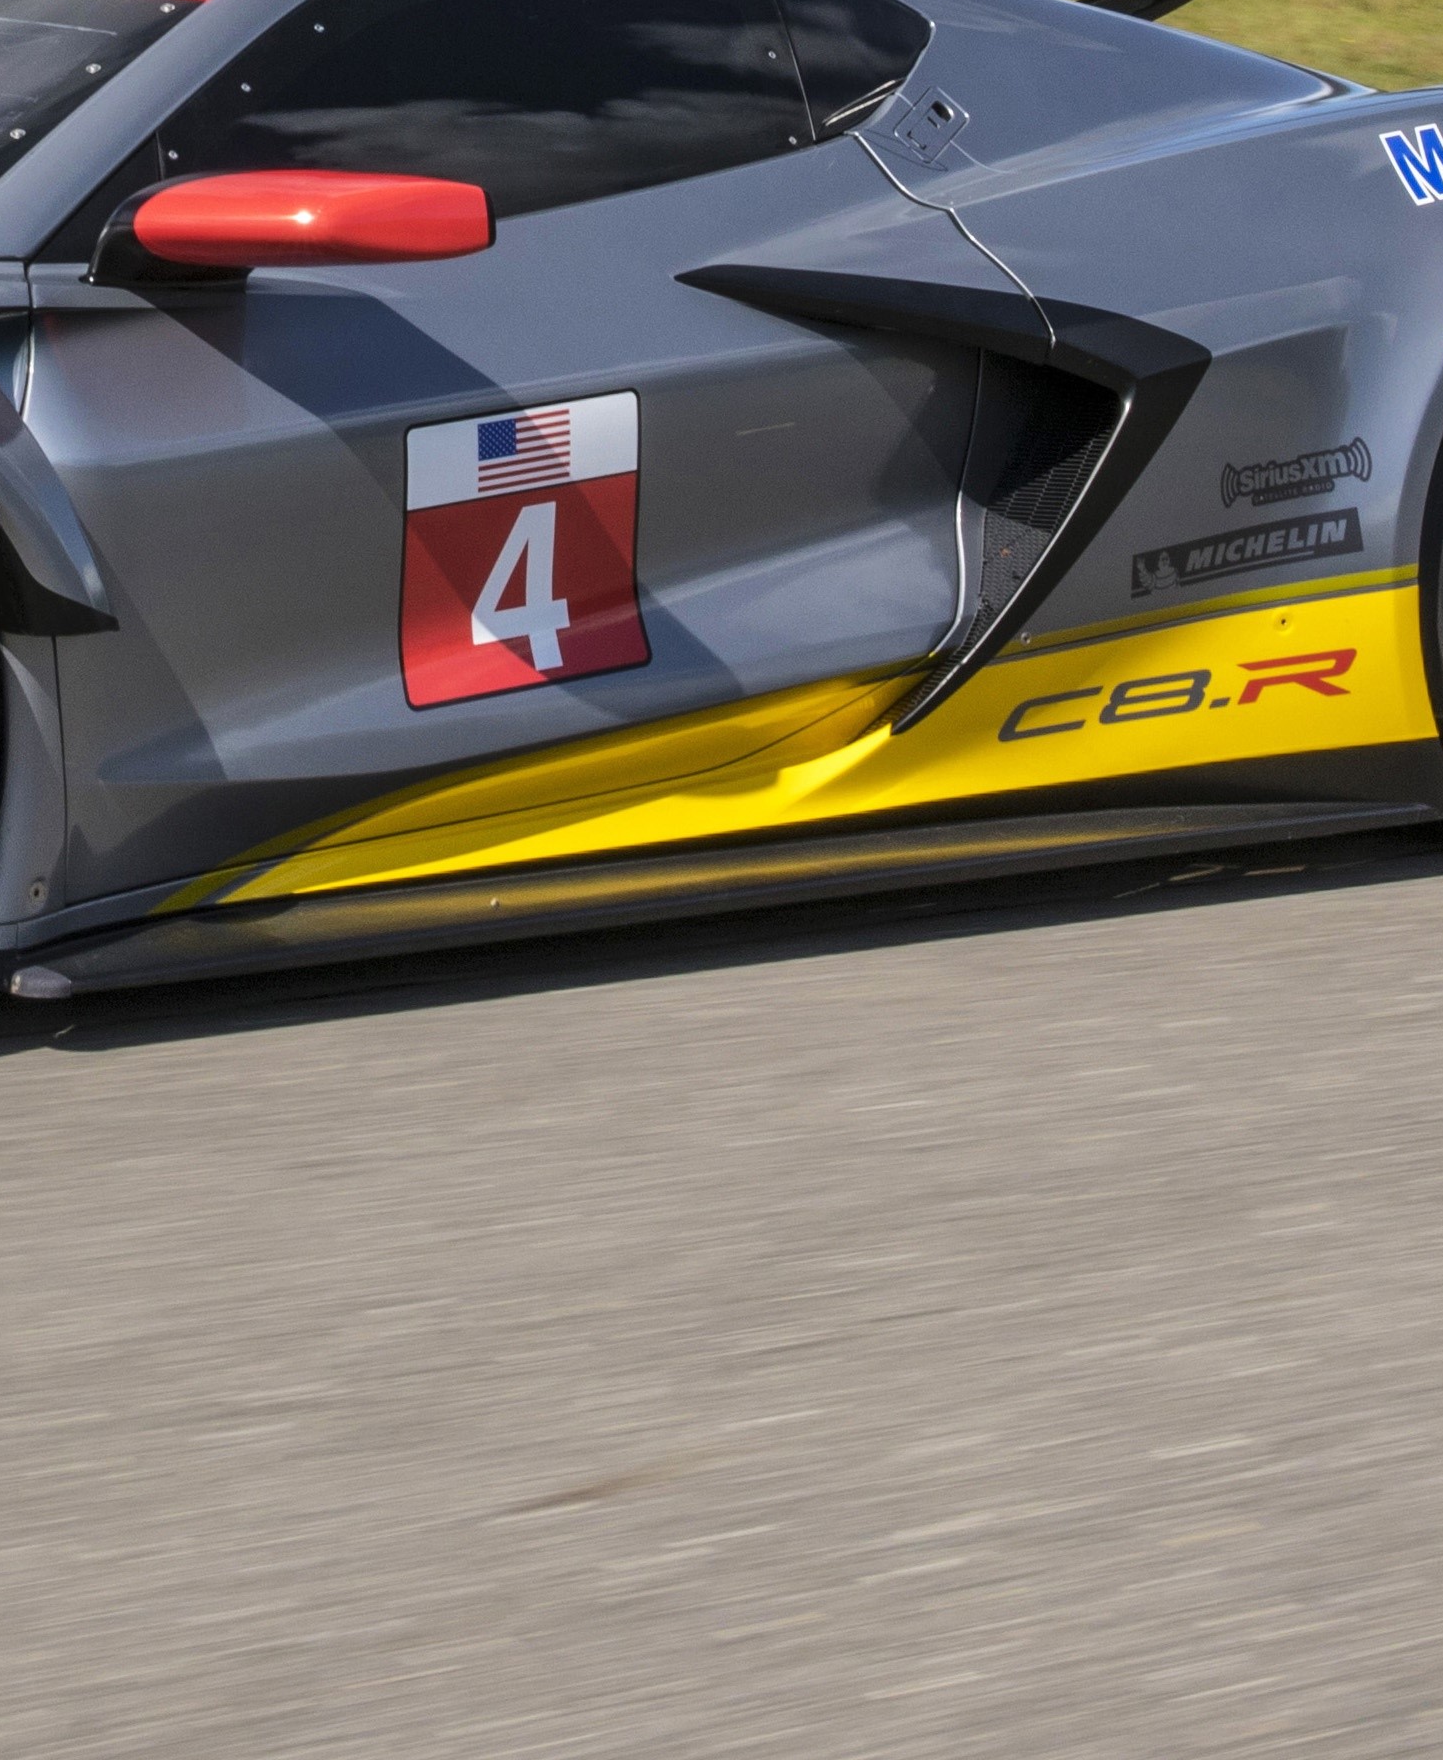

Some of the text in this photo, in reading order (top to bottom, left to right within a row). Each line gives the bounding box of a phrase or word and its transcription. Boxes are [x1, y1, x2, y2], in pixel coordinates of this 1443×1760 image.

[470, 501, 571, 671] 4
[1184, 518, 1348, 572] MICHELIN
[997, 647, 1358, 743] C8.R
